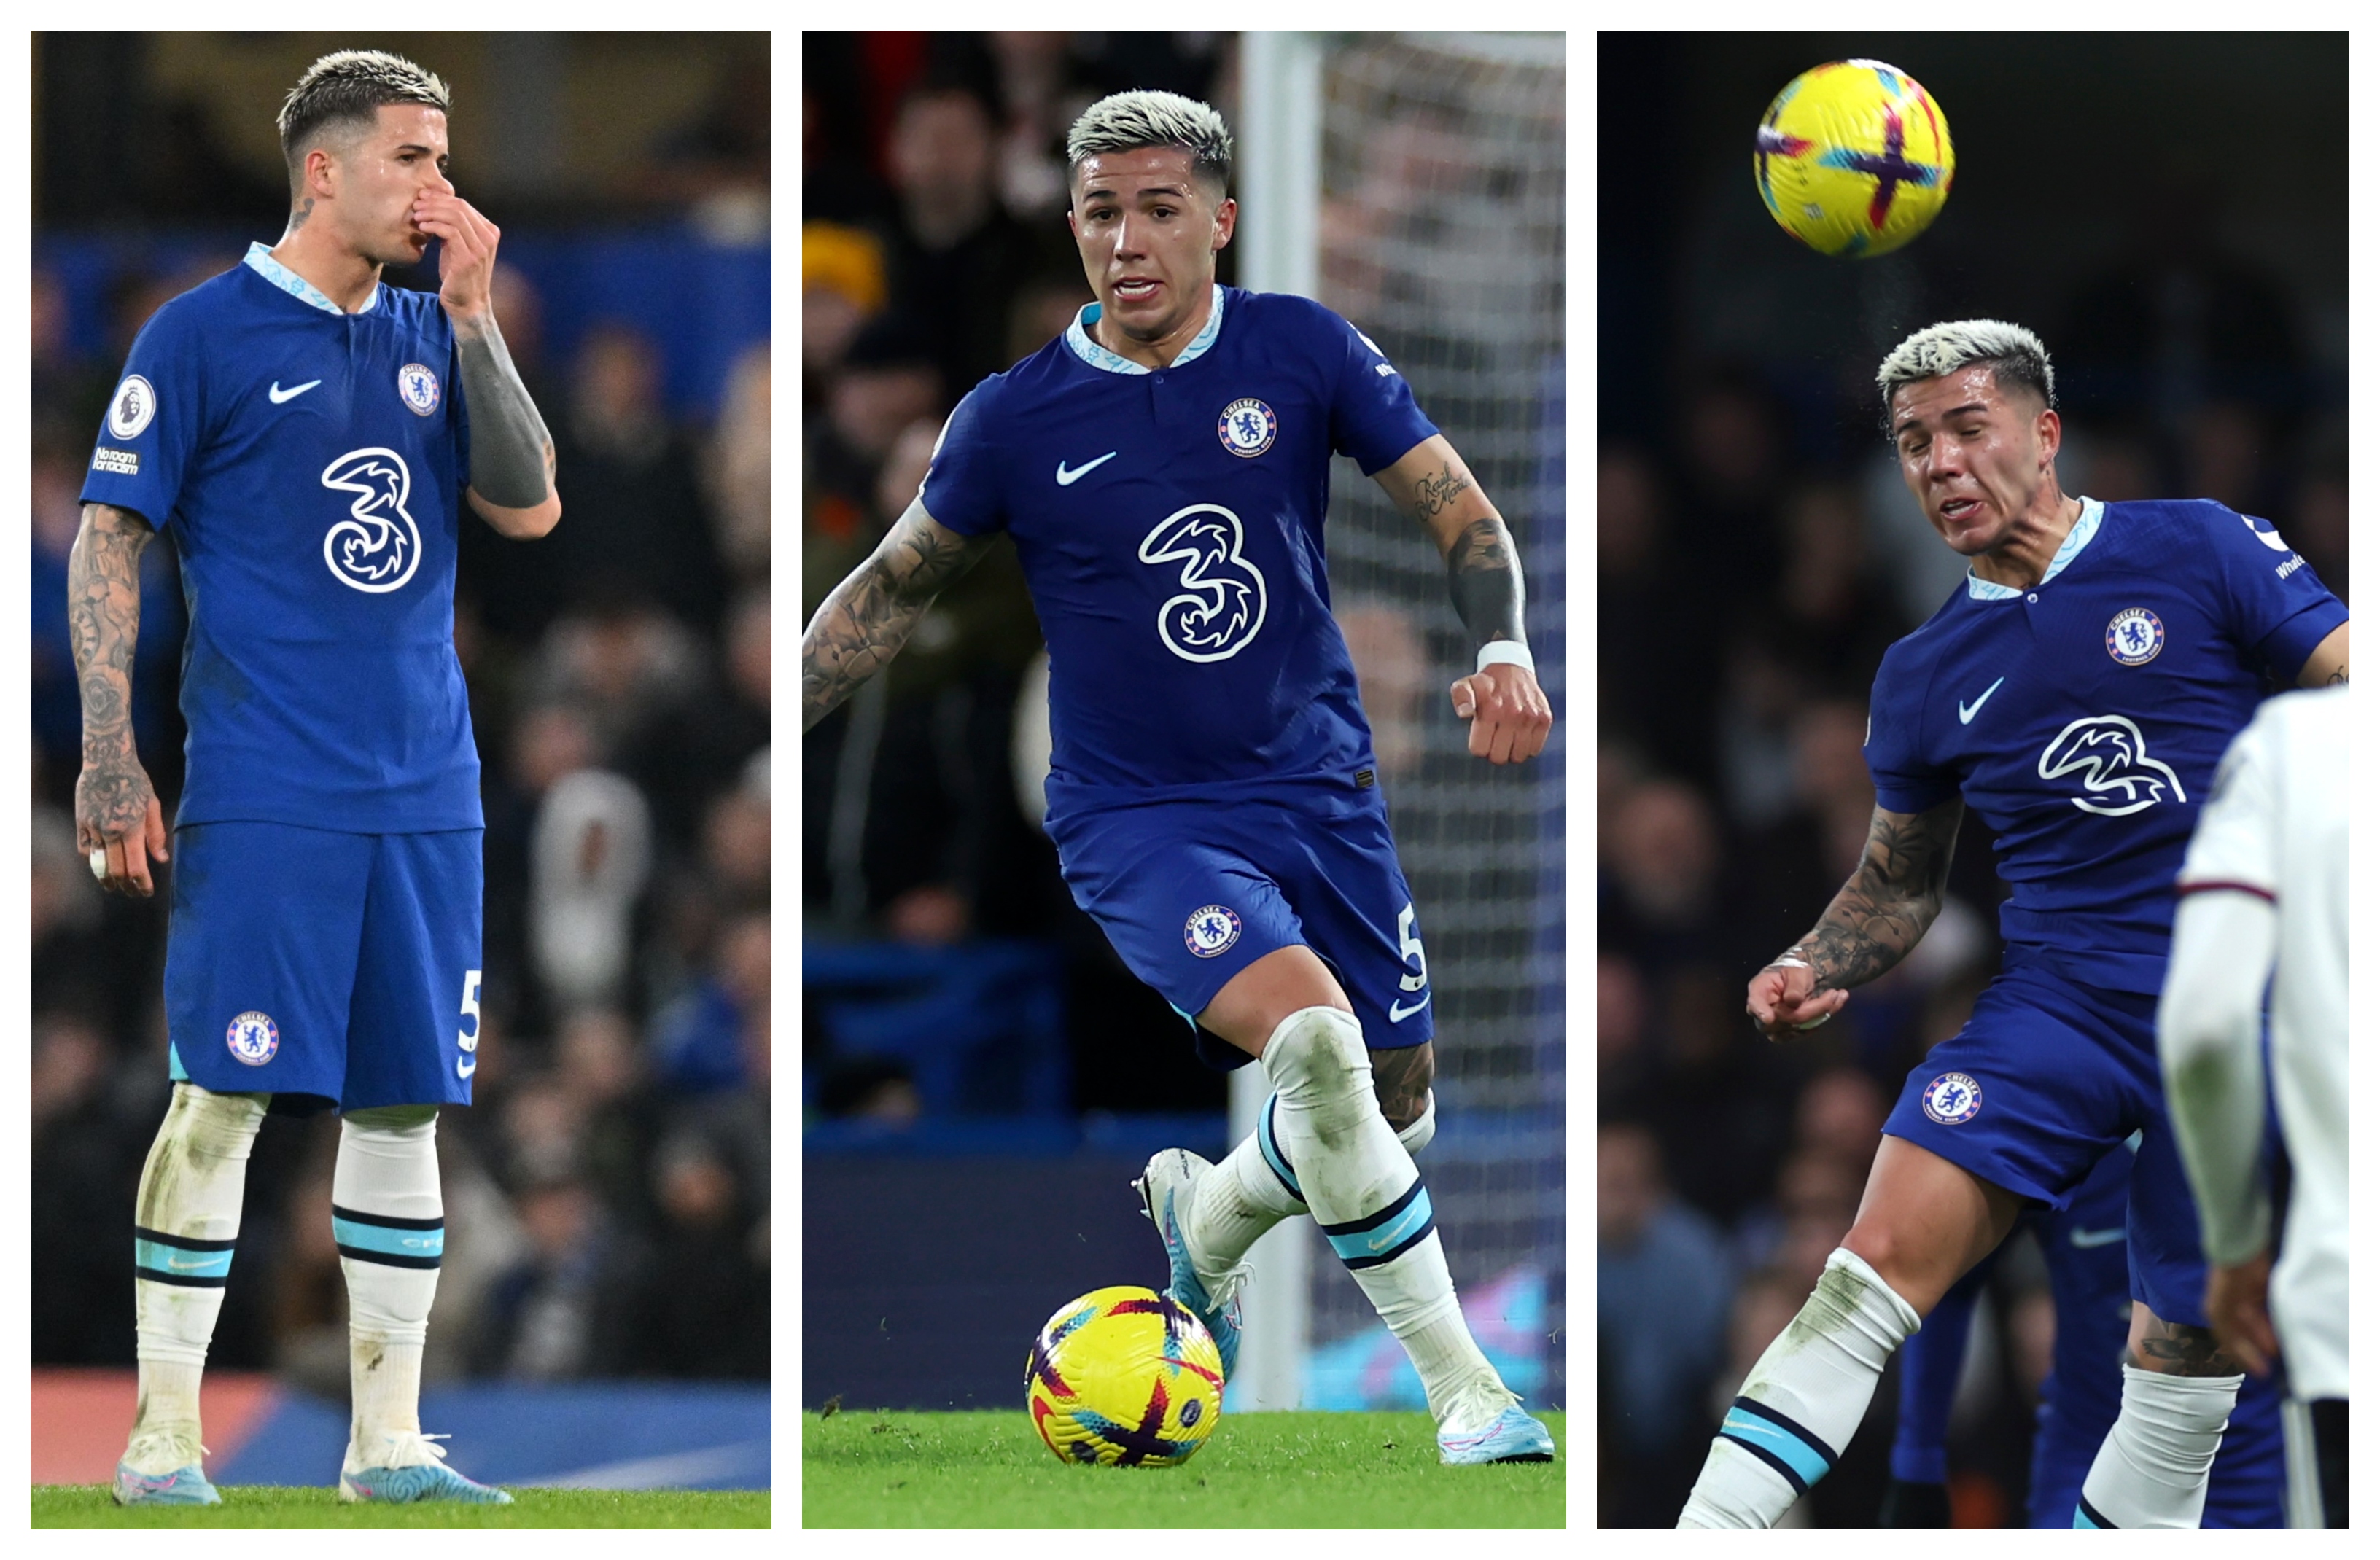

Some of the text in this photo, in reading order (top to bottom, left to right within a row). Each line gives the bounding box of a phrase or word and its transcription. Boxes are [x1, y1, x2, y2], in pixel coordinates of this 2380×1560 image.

[1224, 399, 1259, 418] CHELSEA
[96, 447, 137, 464] No room
[322, 447, 421, 593] 3
[1138, 502, 1267, 663] 3
[2110, 609, 2145, 631] CHELSEA
[1186, 907, 1220, 931] CHELSEA
[1398, 901, 1427, 991] 5
[236, 1013, 270, 1026] CHELSEA
[458, 970, 482, 1053] 5
[1945, 1075, 1979, 1096] CHELSEA
